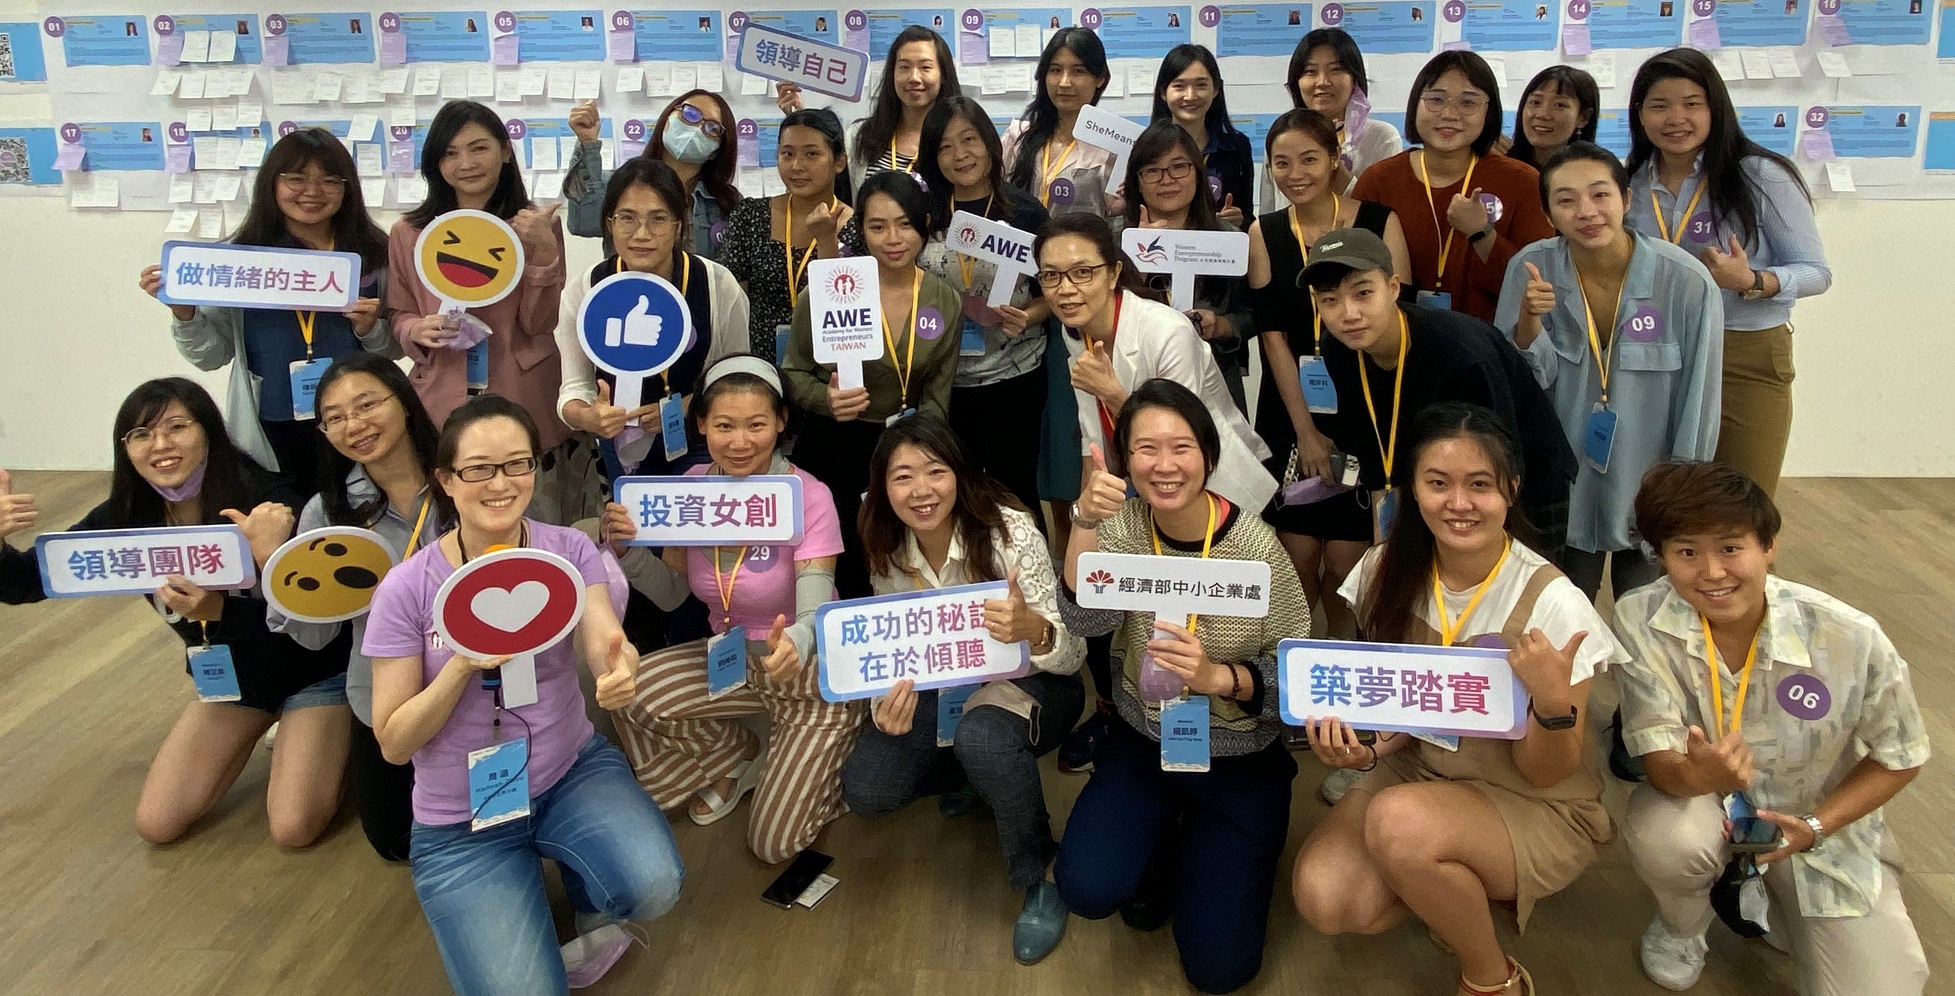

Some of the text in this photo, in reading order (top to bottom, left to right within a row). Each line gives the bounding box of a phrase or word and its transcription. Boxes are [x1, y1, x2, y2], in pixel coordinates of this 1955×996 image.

[1573, 4, 1586, 13] 14
[1698, 1, 1711, 10] 15
[1205, 12, 1215, 20] 11
[1326, 10, 1338, 18] 12
[1449, 7, 1461, 16] 13
[384, 19, 396, 27] 04
[499, 18, 512, 26] 05
[617, 17, 629, 25] 06
[733, 18, 745, 26] 07
[849, 17, 862, 25] 08
[966, 16, 979, 24] 09
[1085, 15, 1097, 23] 10
[48, 23, 60, 31] 01
[158, 22, 170, 30] 02
[270, 21, 282, 29] 03
[756, 39, 847, 85] 領導自己
[1811, 113, 1823, 121] 32
[66, 129, 76, 137] 17
[174, 128, 184, 136] 18
[395, 126, 407, 134] 20
[509, 125, 521, 133] 21
[629, 126, 640, 134] 22
[741, 125, 753, 133] 23
[1054, 186, 1069, 197] 03
[1693, 221, 1712, 234] 31
[980, 234, 1031, 263] AWE
[176, 262, 344, 294] 做情緒的主人
[822, 308, 872, 329] AWE
[920, 317, 937, 331] 04
[1632, 316, 1655, 332] 09
[822, 333, 874, 343] Entrepreneurs
[831, 341, 866, 351] TAIWAN
[639, 493, 777, 528] 投資女創
[750, 546, 770, 561] 29
[67, 543, 225, 580] 領導團隊
[1118, 576, 1262, 601] 經濟部中小企業處
[859, 638, 986, 683] 在於傾聽
[1310, 663, 1490, 715] 築夢踏實
[1788, 685, 1820, 709] 06
